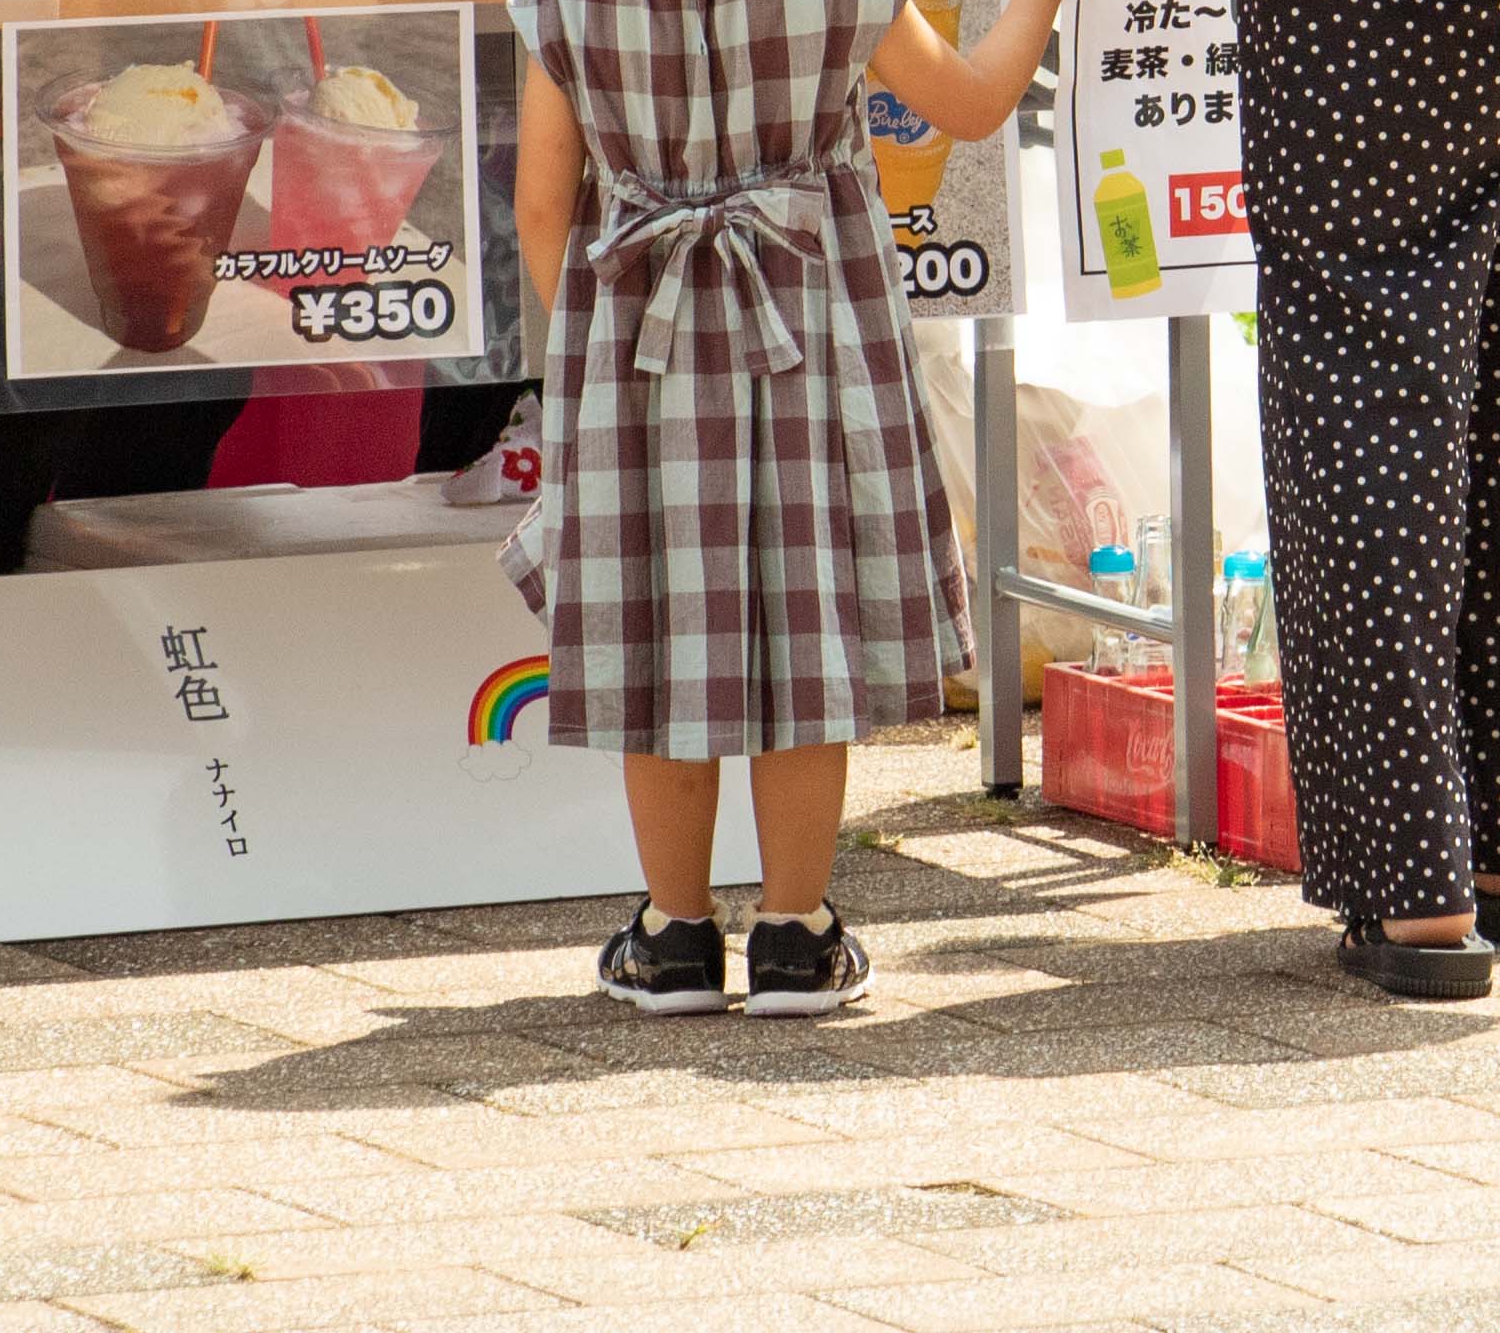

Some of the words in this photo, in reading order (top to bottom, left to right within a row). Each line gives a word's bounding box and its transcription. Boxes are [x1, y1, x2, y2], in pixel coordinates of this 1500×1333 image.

[1099, 40, 1241, 83] 麦茶・緑
[1132, 88, 1235, 129] ありま
[1171, 178, 1248, 222] 150
[1109, 214, 1143, 259] お茶
[214, 242, 452, 281] カラフルクリームソーダ
[160, 623, 229, 724] 虹色
[204, 757, 250, 859] ナナイロ
